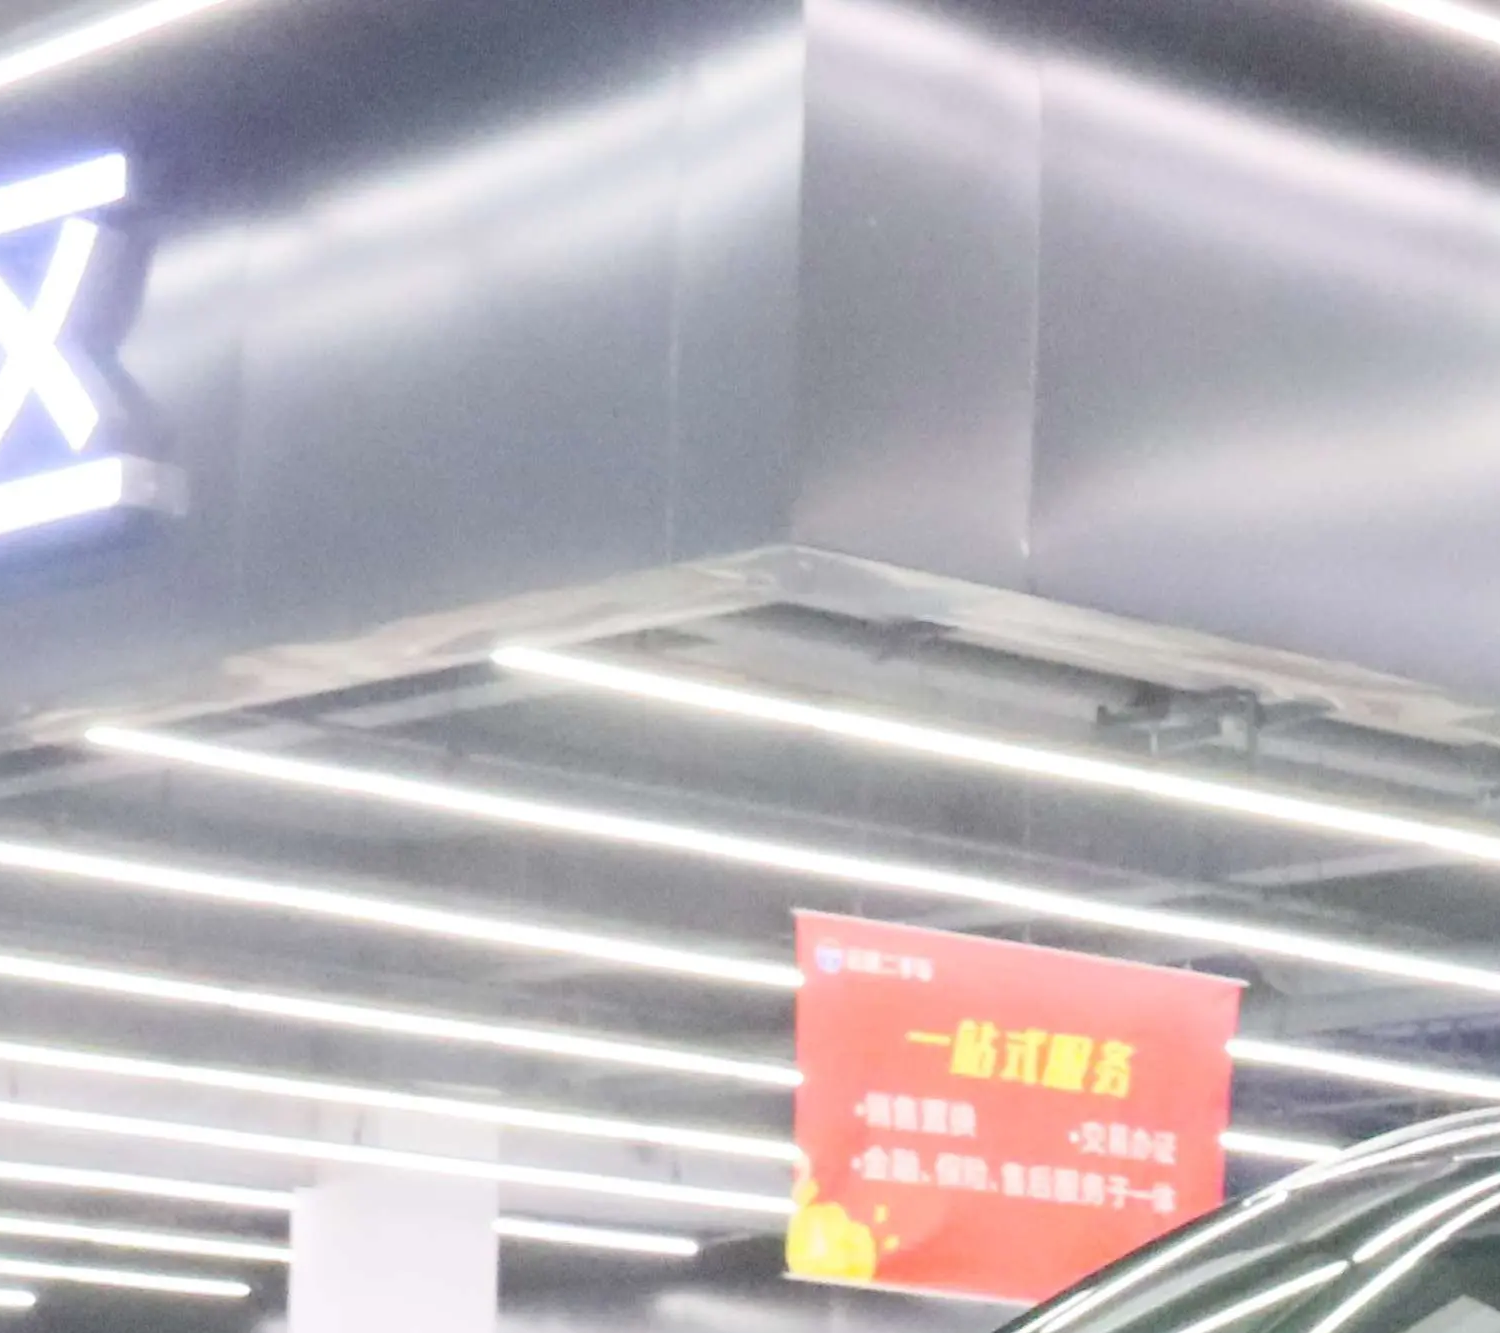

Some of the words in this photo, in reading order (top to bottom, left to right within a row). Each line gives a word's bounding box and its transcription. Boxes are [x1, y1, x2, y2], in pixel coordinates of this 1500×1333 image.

[905, 1019, 1137, 1098] 一站式服务
